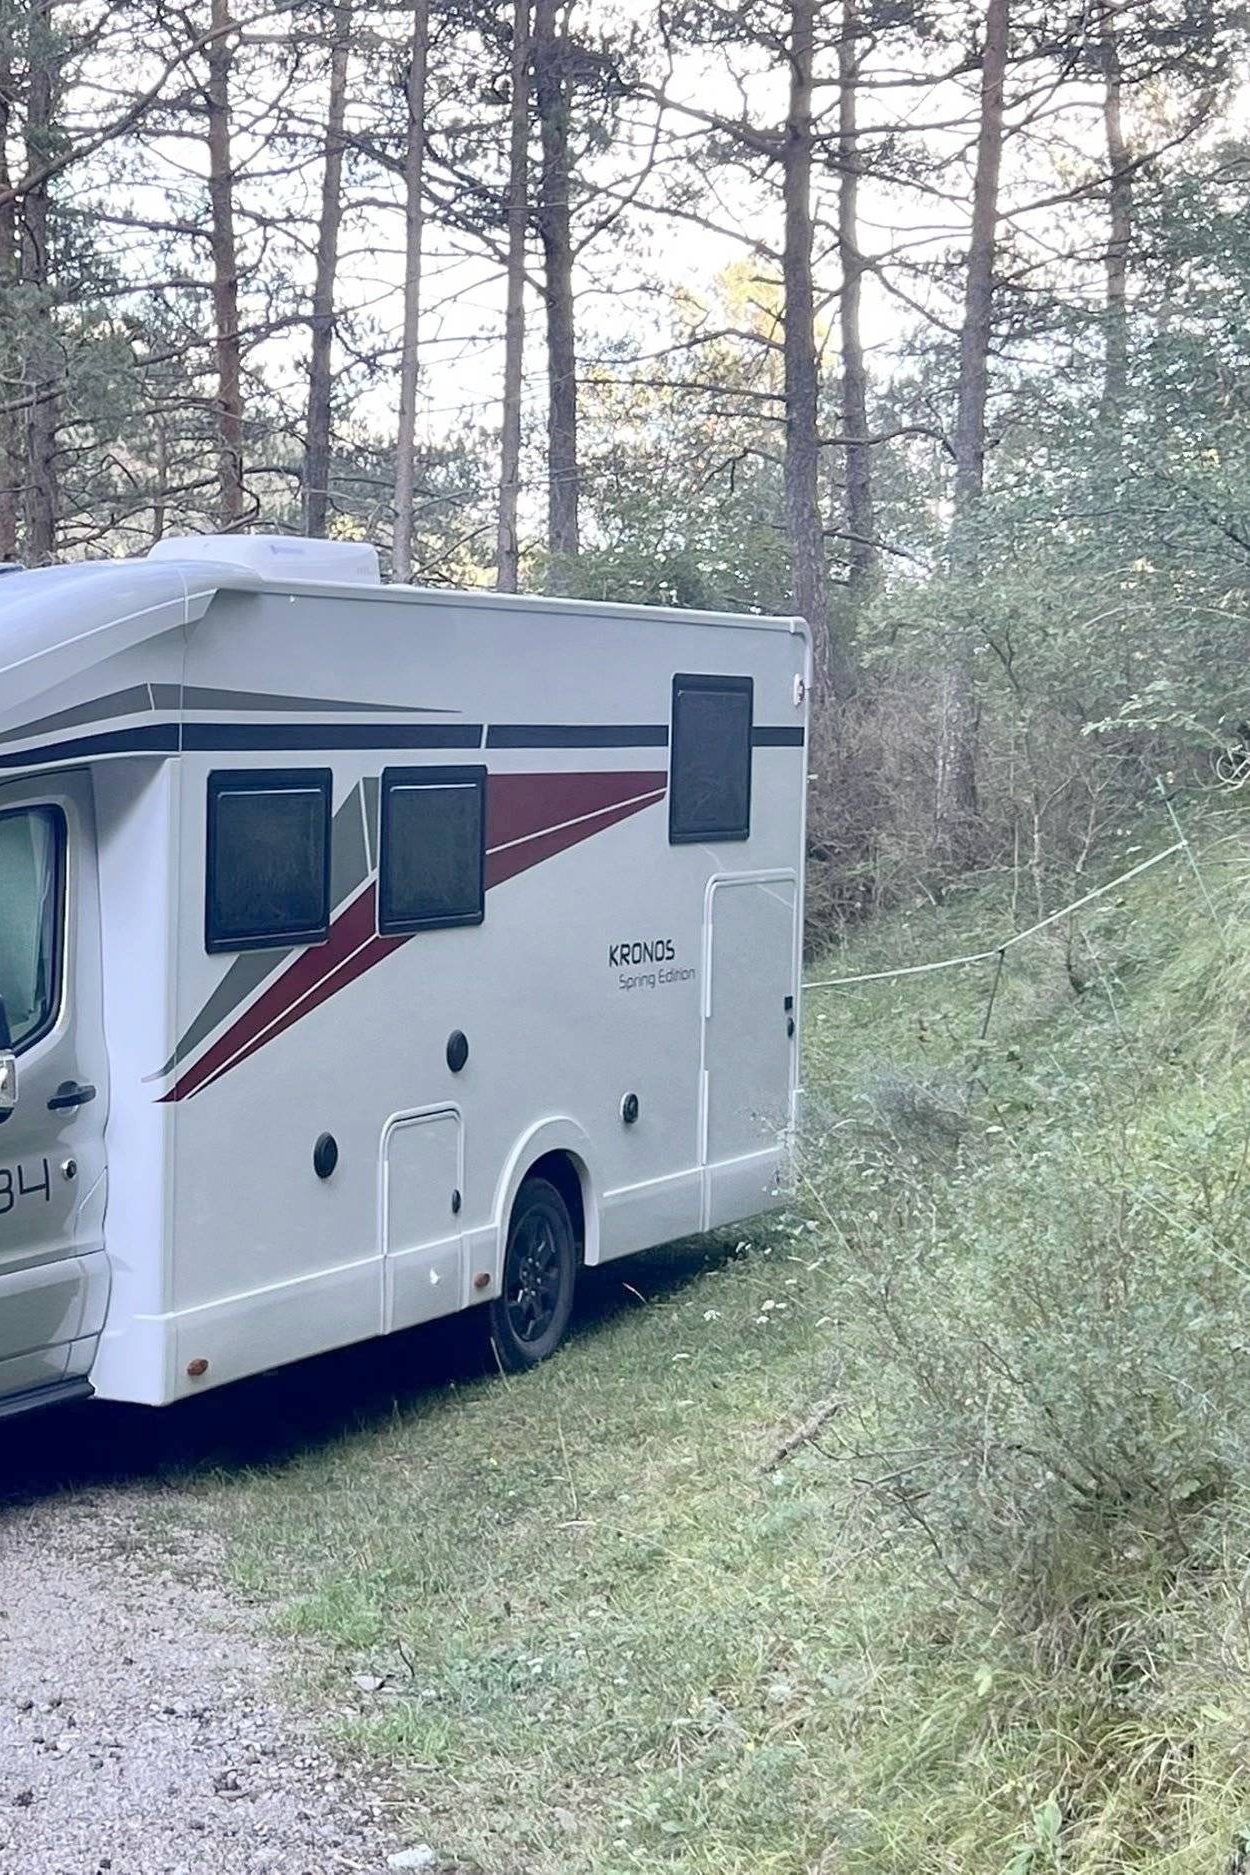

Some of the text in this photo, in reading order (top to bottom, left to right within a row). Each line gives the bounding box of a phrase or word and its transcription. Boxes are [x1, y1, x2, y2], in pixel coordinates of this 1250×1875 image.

[609, 939, 675, 967] KRONOS
[618, 968, 696, 991] Spring Edition
